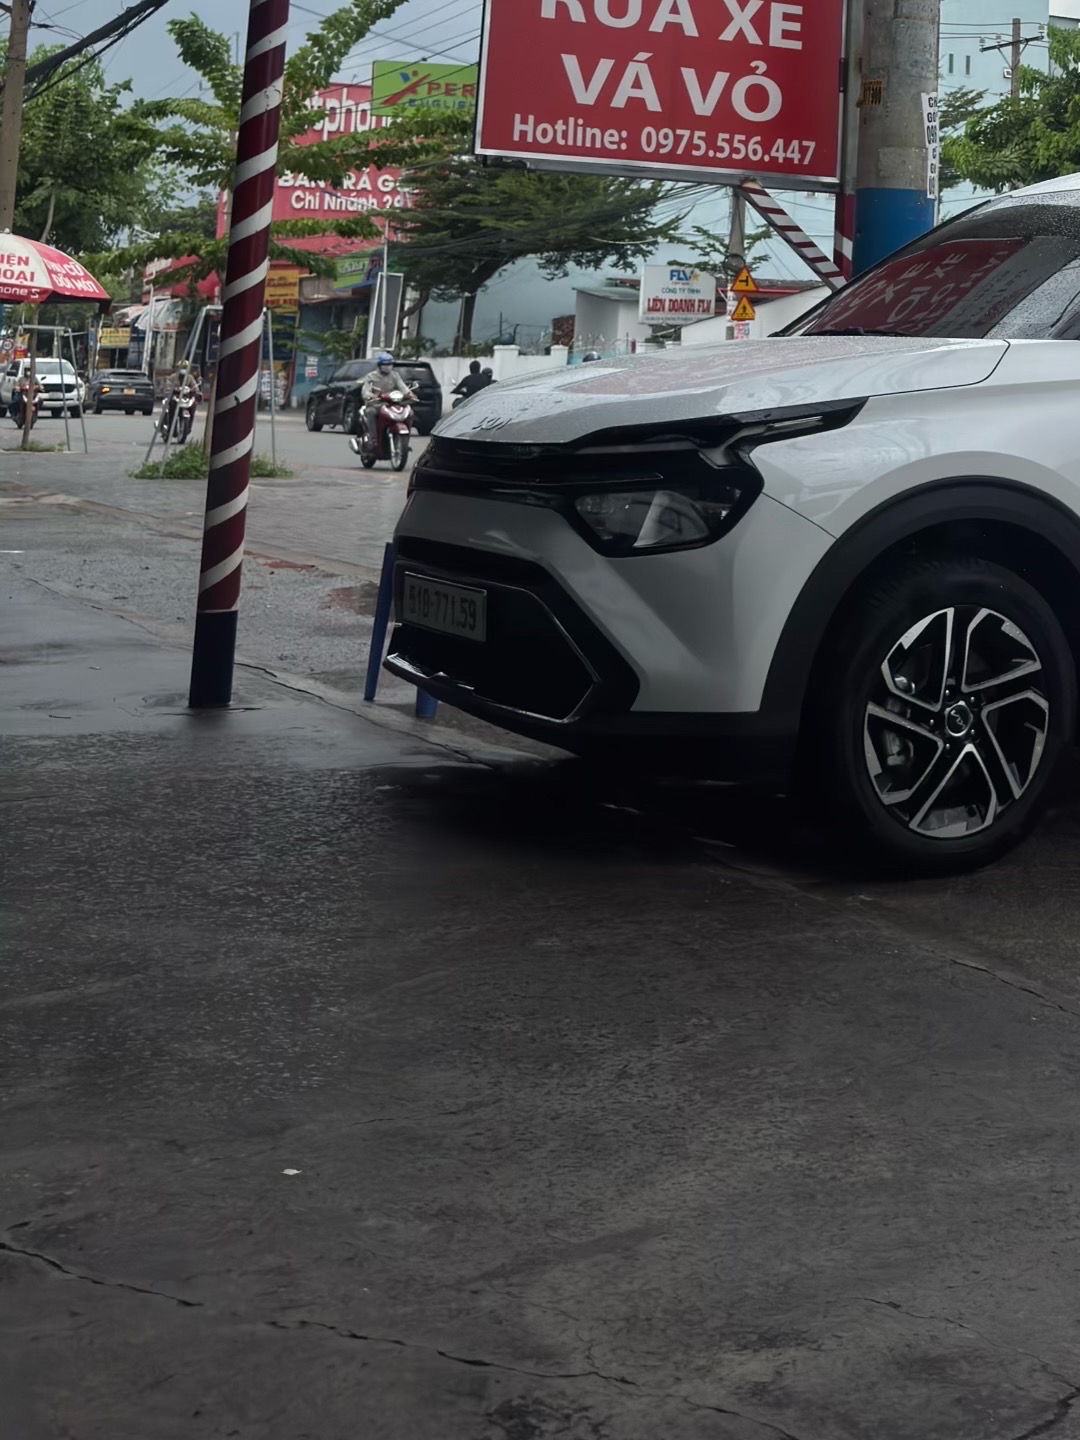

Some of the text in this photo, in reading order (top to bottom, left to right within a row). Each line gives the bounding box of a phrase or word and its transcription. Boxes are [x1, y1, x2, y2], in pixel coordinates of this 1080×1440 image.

[561, 51, 783, 123] VÁ VỎ
[512, 113, 816, 165] Hotline: 0975.556.447
[291, 190, 320, 209] Chi
[0, 268, 35, 283] OẠI
[668, 298, 696, 313] DOANH
